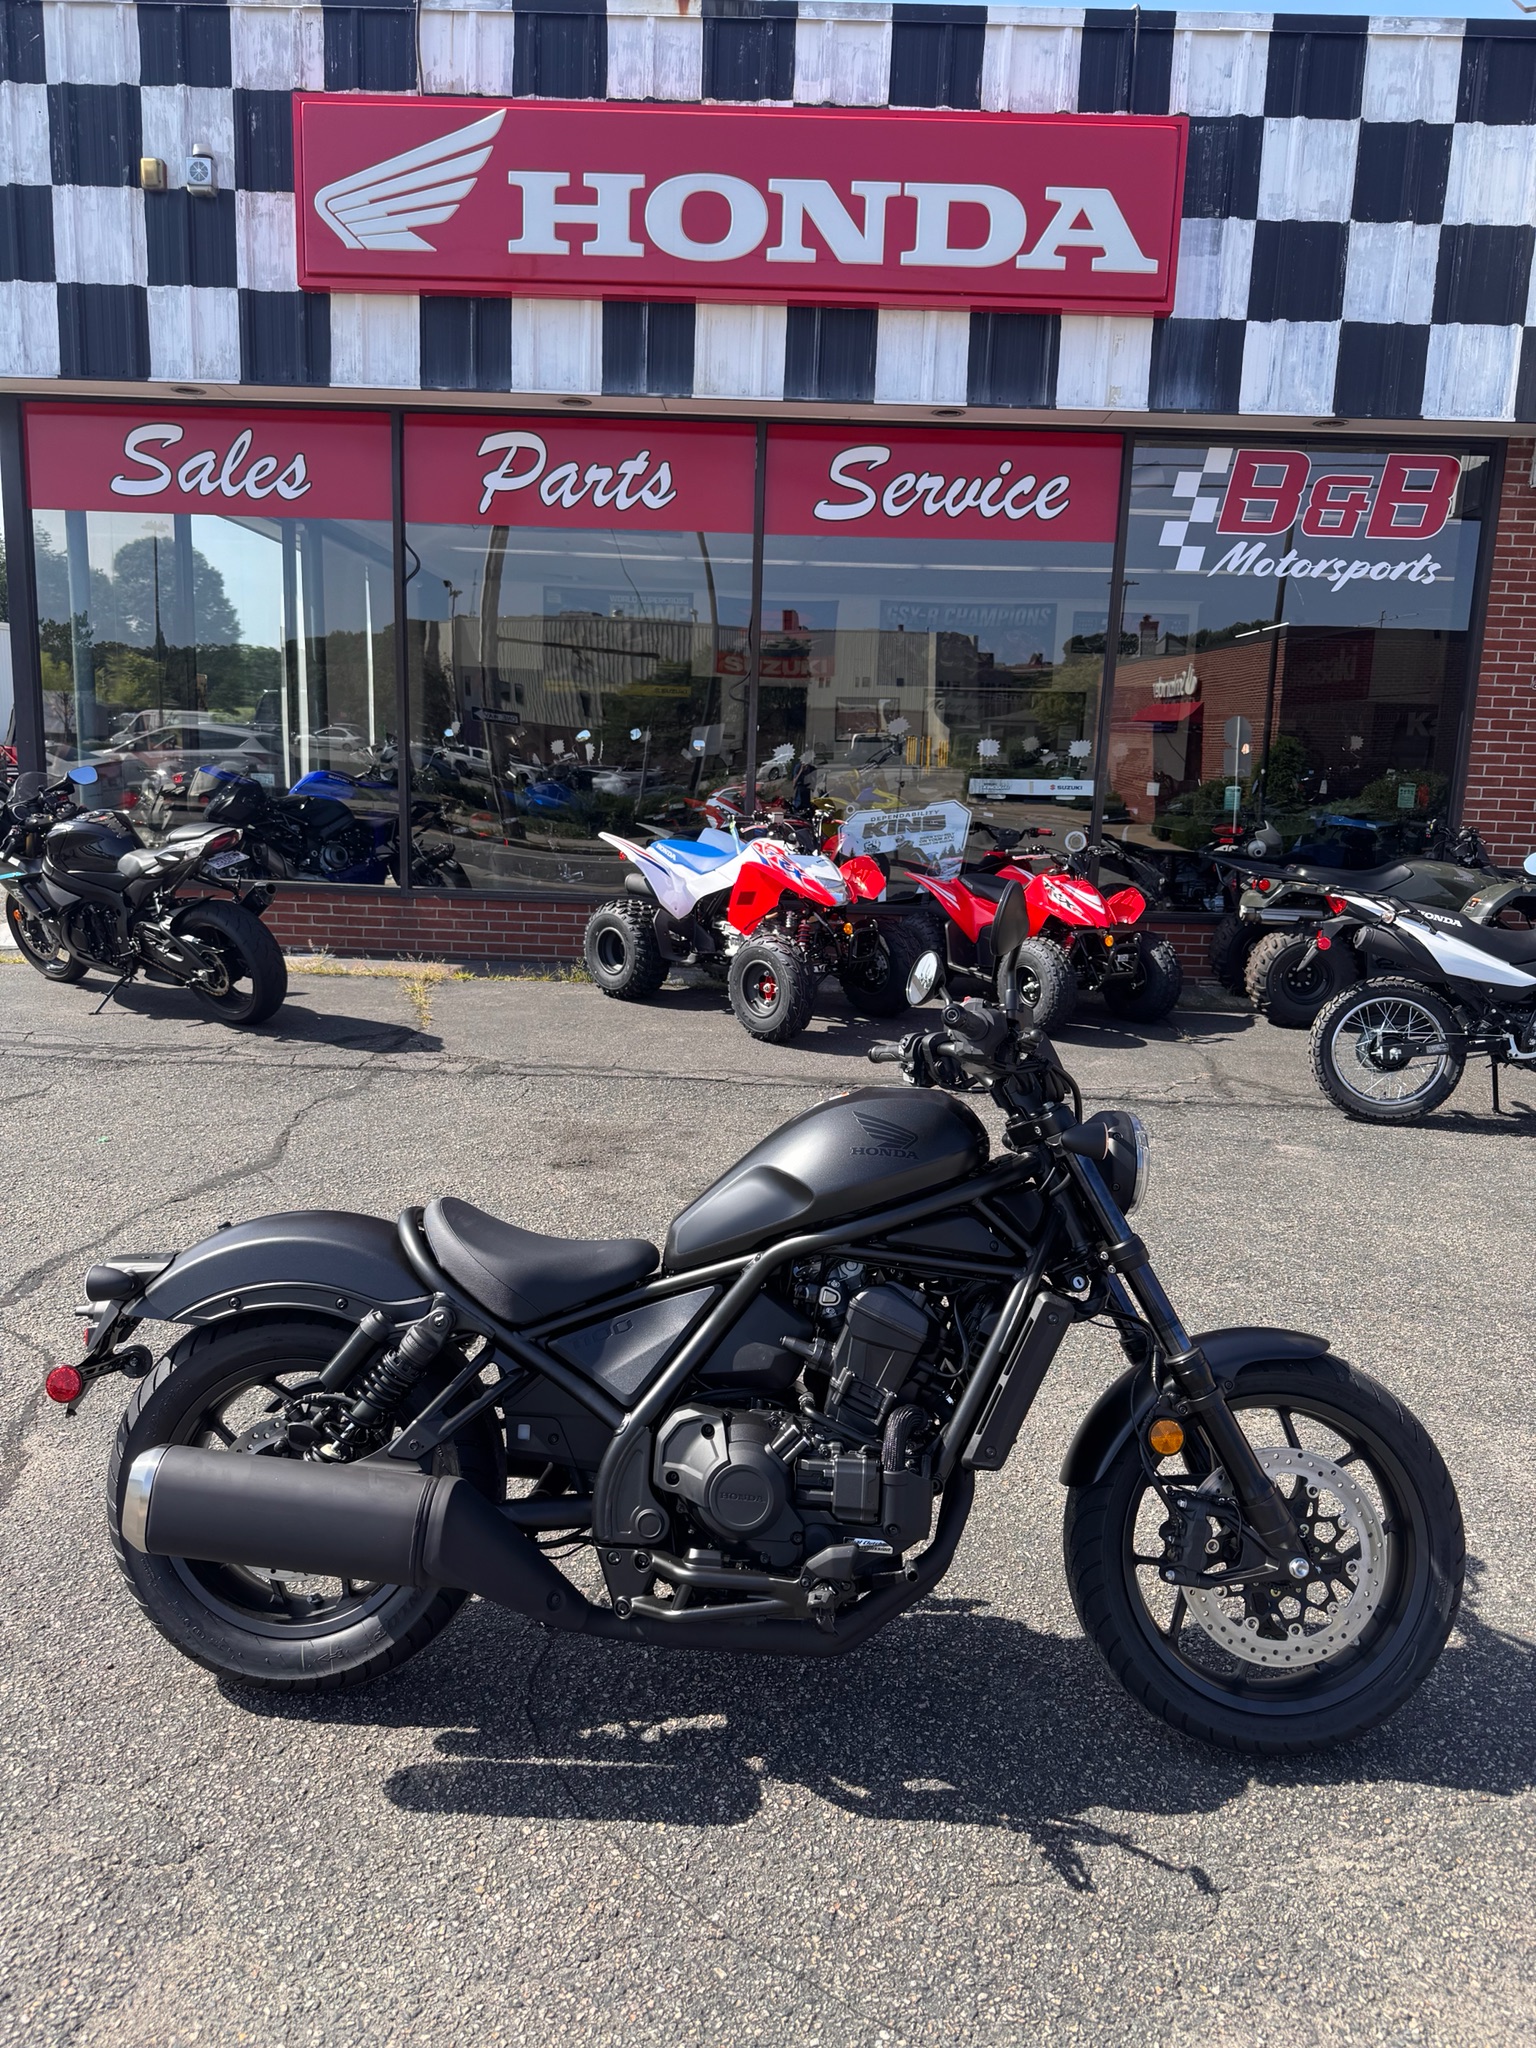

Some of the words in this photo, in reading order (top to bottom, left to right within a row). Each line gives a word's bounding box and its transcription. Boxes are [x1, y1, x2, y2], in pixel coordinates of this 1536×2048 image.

[508, 170, 1160, 275] HONDA
[110, 423, 312, 500] Sales
[477, 430, 678, 515] Parts
[813, 445, 1072, 521] Service
[1216, 449, 1462, 541] B&B
[1208, 541, 1442, 592] Motorsports
[887, 604, 940, 625] GSX-R
[944, 606, 1051, 627] CHAMPIONS
[724, 655, 828, 675] SZUKI
[870, 809, 940, 822] DEPENDABILITY
[850, 1146, 919, 1160] HONDA
[719, 1491, 766, 1503] HONDA
